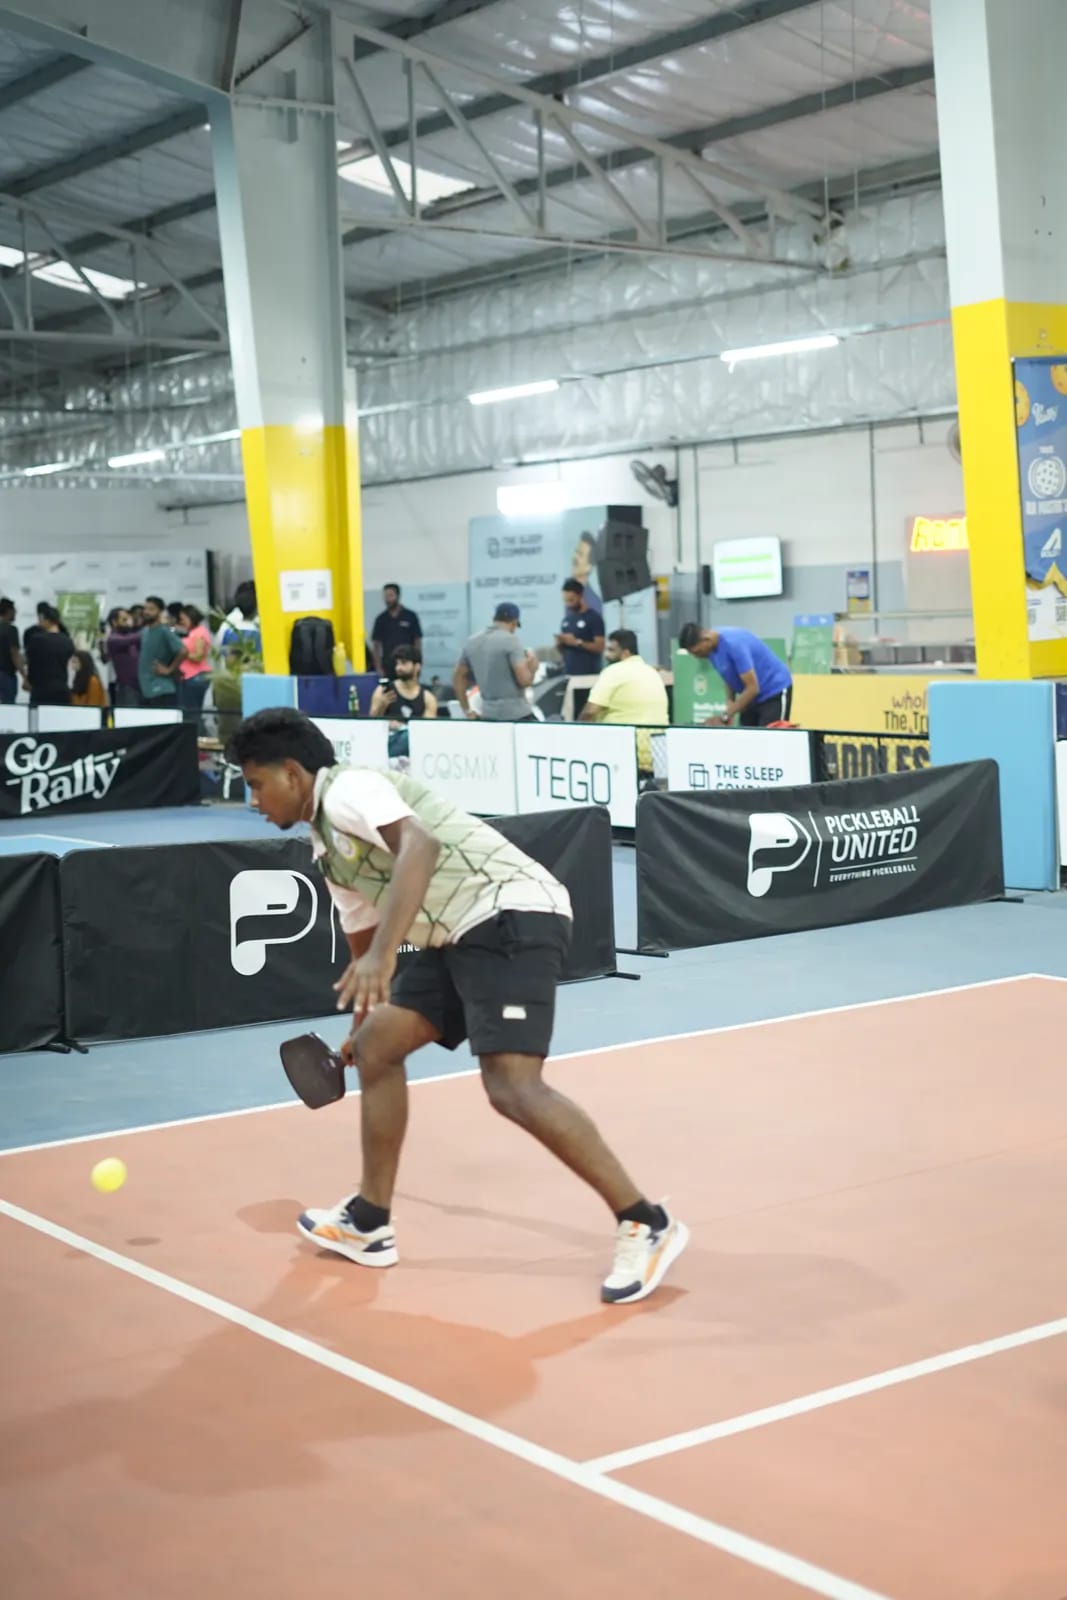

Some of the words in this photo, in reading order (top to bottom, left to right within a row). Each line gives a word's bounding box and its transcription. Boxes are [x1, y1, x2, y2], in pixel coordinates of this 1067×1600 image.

[884, 710, 907, 731] The
[5, 736, 58, 775] Go
[20, 753, 120, 815] Rally
[527, 755, 611, 805] TEGO
[715, 764, 739, 779] THE
[744, 766, 784, 782] SLEEP
[824, 805, 921, 834] PICKLEBALL
[831, 826, 918, 863] UNITED
[829, 869, 872, 883] EVERYTHING
[872, 863, 917, 876] PICKLEBALL
